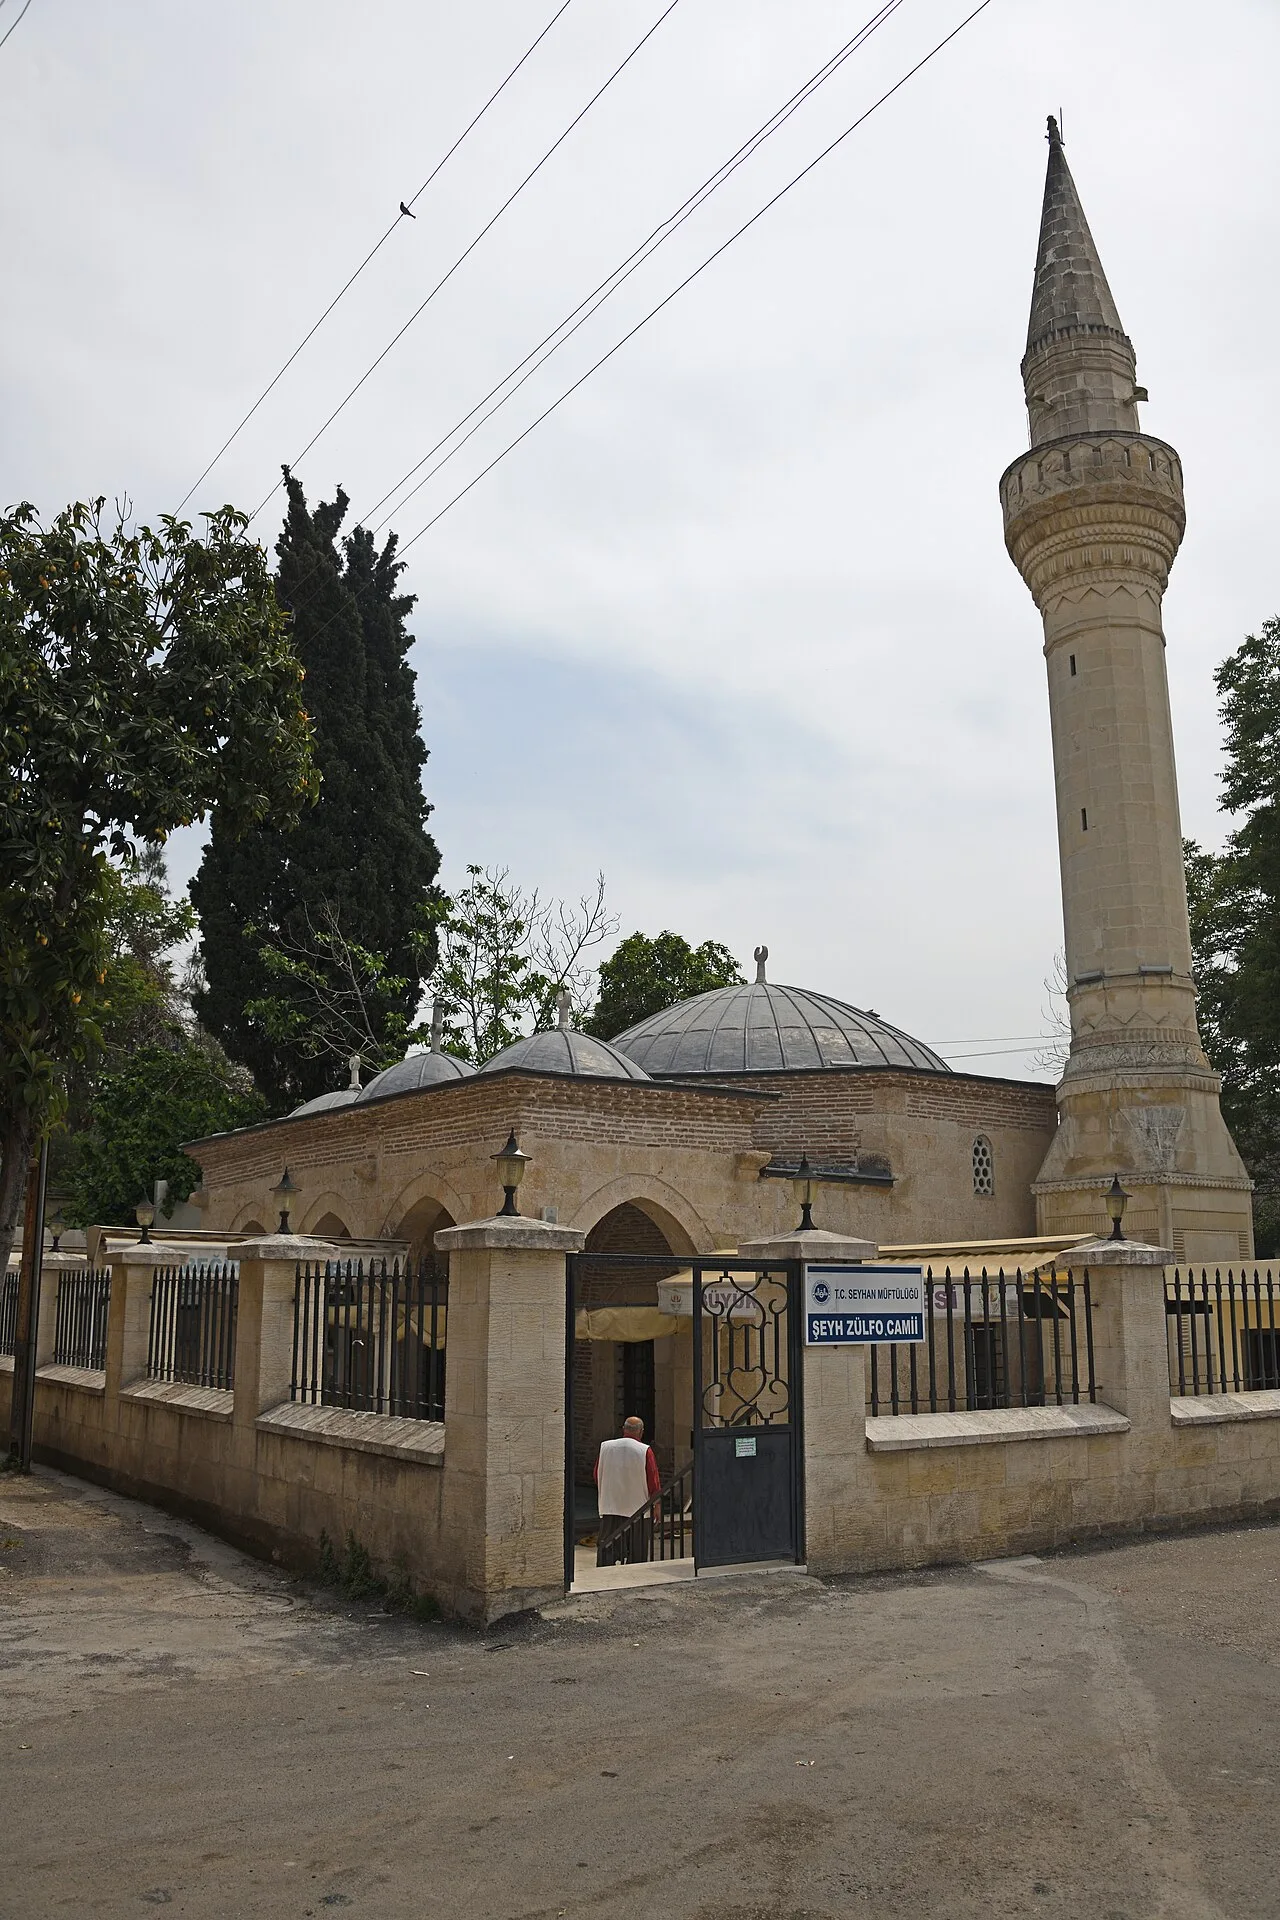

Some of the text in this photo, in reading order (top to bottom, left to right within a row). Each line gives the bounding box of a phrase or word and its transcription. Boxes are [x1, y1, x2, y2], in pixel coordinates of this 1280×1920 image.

[834, 1289, 847, 1300] T.C.
[848, 1289, 877, 1300] SEYHAN
[877, 1287, 919, 1300] MÜFTÜLÜĞÜ
[812, 1320, 844, 1340] ŞEYH
[846, 1316, 884, 1336] ZÜLFO
